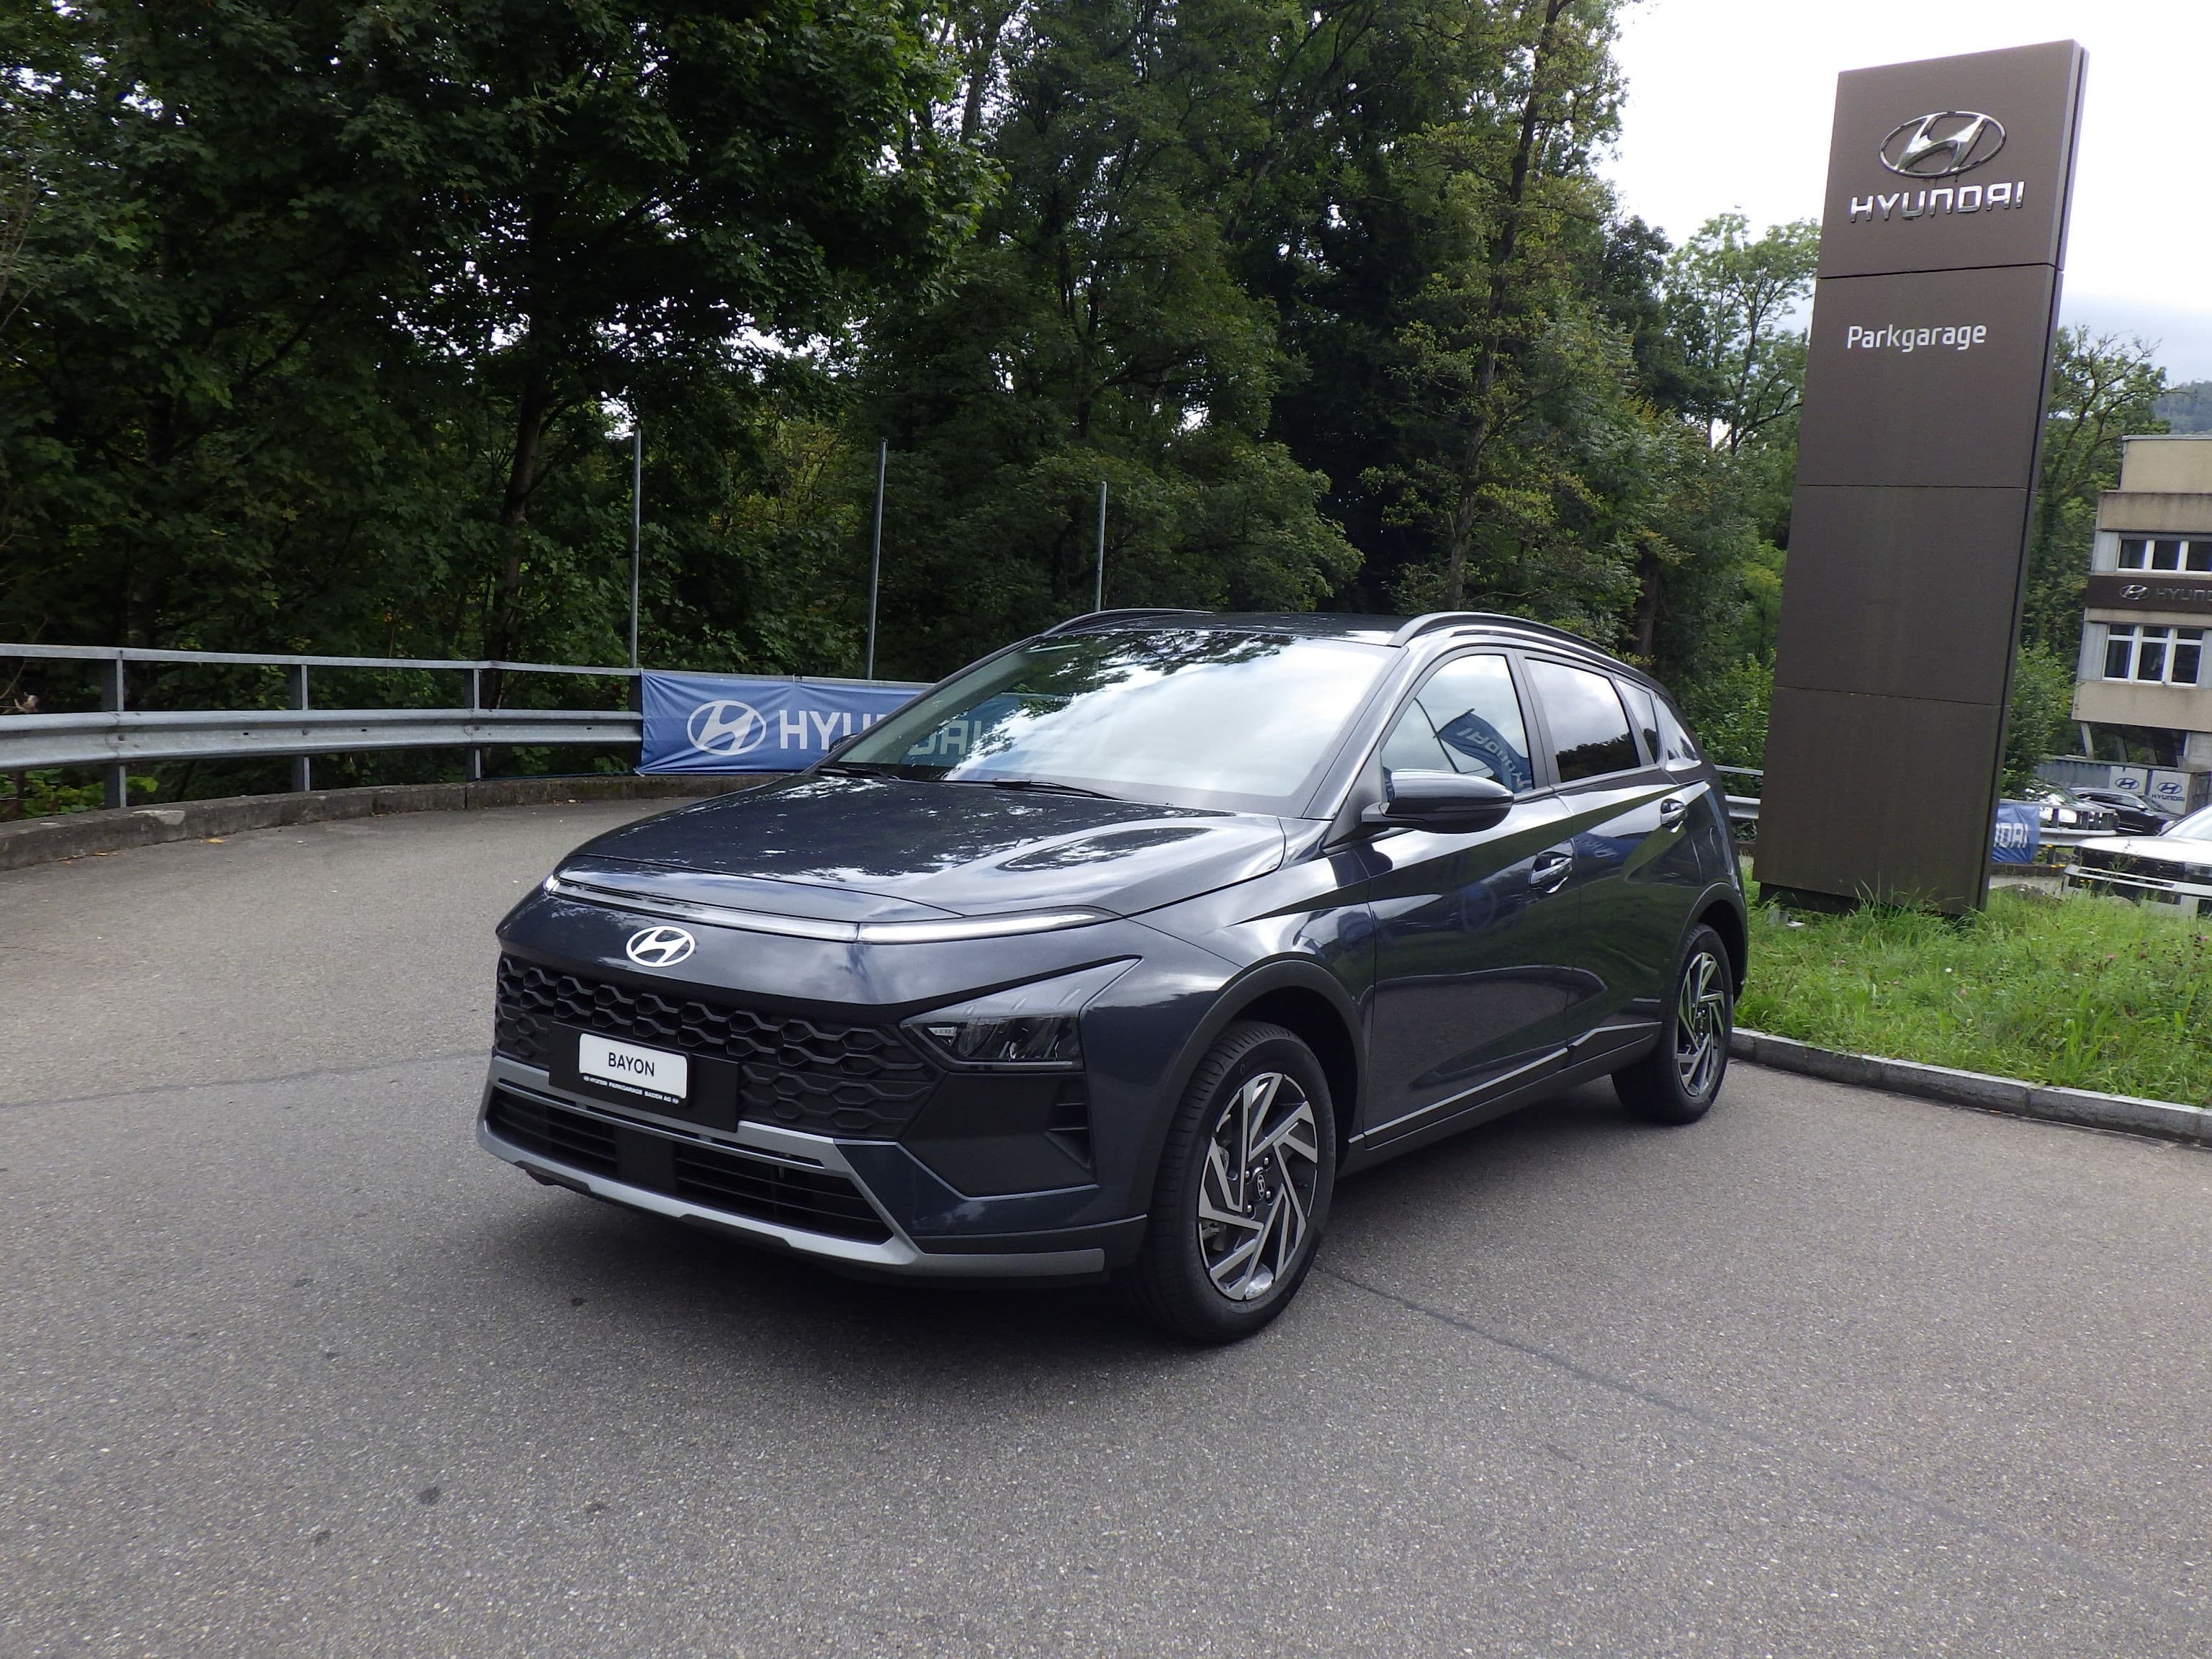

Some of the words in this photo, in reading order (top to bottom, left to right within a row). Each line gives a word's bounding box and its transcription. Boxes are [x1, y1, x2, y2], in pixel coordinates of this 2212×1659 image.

[1850, 181, 2026, 223] HYUNDAI
[1847, 324, 1987, 352] Parkgarage
[2152, 793, 2185, 802] HYUNDAI
[608, 1052, 655, 1077] BAYON
